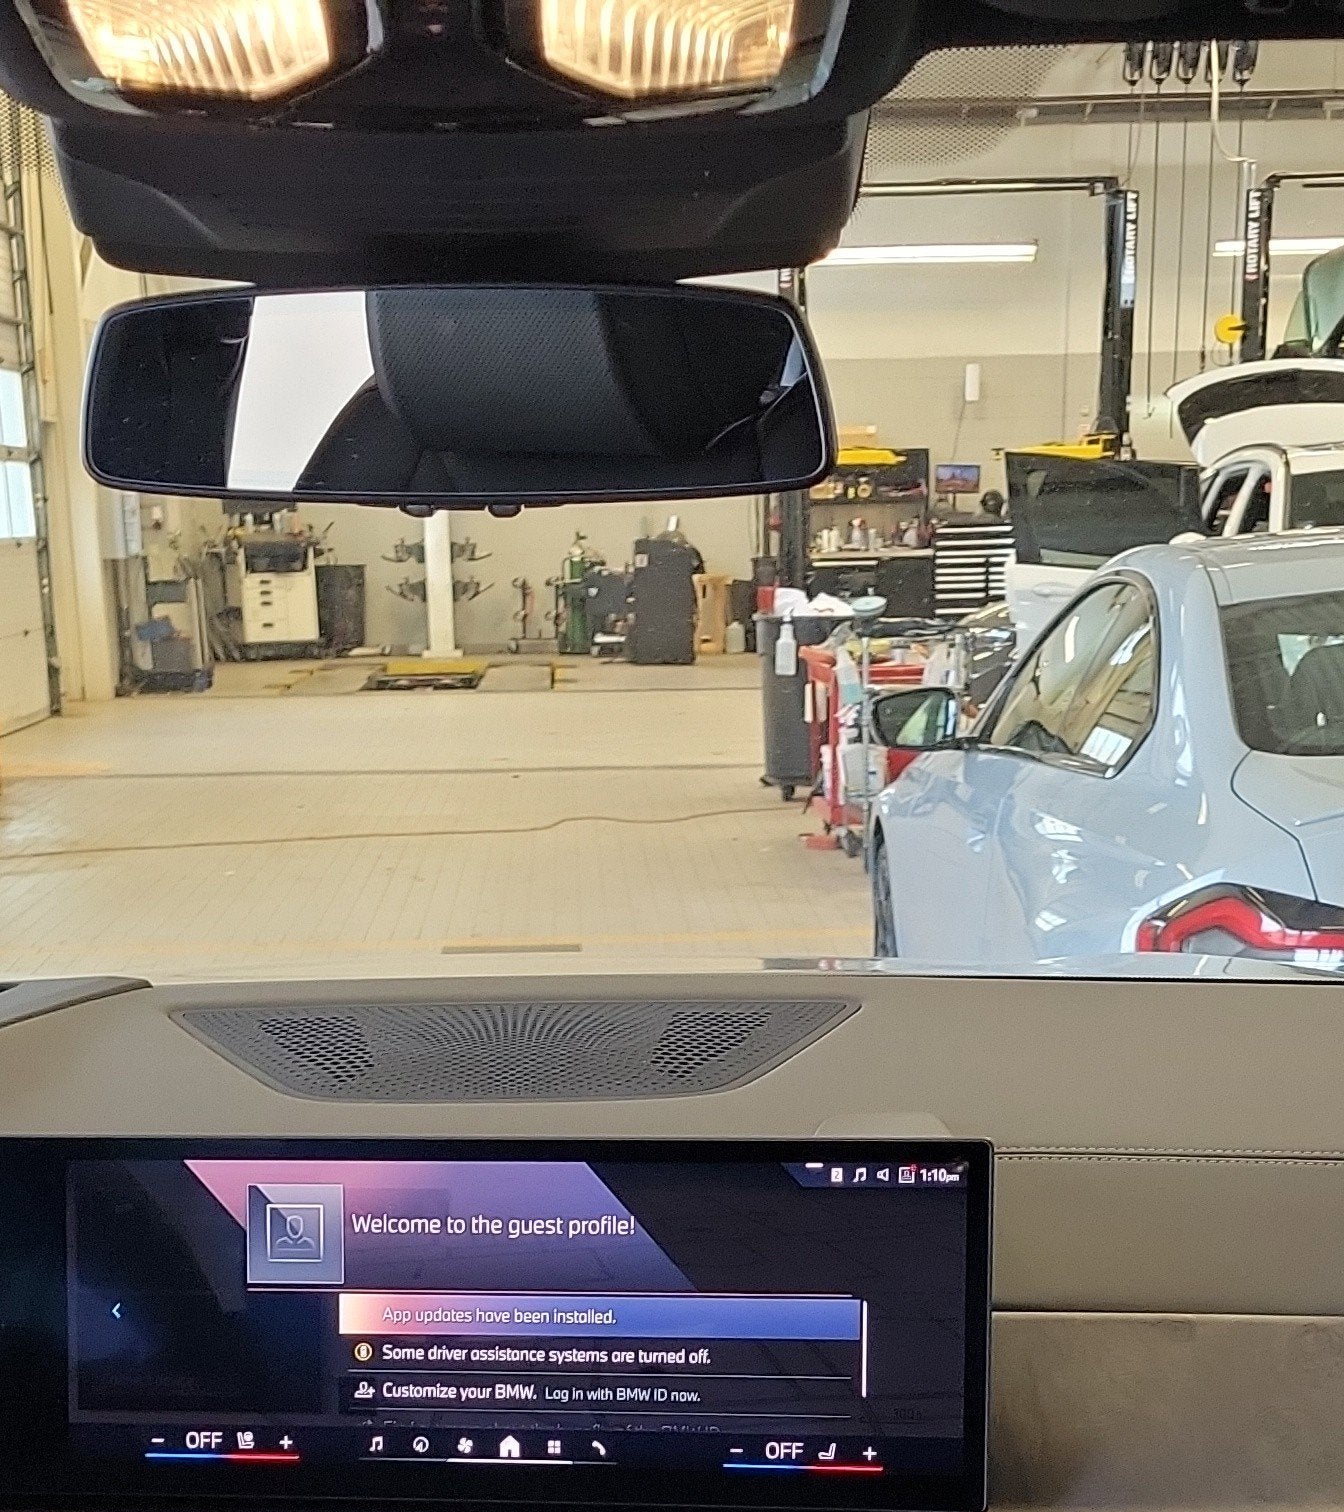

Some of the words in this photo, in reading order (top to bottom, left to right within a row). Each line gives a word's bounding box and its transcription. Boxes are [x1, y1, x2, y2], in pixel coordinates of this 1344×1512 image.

[919, 1167, 961, 1183] 1:10pm
[351, 1213, 441, 1234] Welcome
[446, 1216, 466, 1234] to
[470, 1214, 503, 1235] the
[508, 1216, 564, 1239] guest
[568, 1215, 636, 1239] profile!
[381, 1306, 412, 1324] App
[414, 1307, 473, 1326] updates
[475, 1307, 511, 1323] have
[513, 1308, 550, 1324] been
[552, 1308, 618, 1325] installed.
[381, 1344, 425, 1361] Some
[427, 1344, 469, 1361] driver
[470, 1345, 546, 1363] assistance
[548, 1347, 609, 1365] systems
[611, 1351, 635, 1364] are
[638, 1349, 686, 1365] turned
[688, 1348, 712, 1365] off.
[381, 1381, 457, 1399] Customize
[459, 1384, 493, 1402] your
[494, 1383, 539, 1400] BMW.
[545, 1386, 570, 1403] Log
[571, 1387, 584, 1401] in
[585, 1387, 614, 1401] with
[616, 1387, 651, 1402] BMW
[653, 1388, 668, 1402] ID
[670, 1390, 702, 1403] now.
[185, 1430, 224, 1450] OFF
[764, 1441, 805, 1461] OFF
